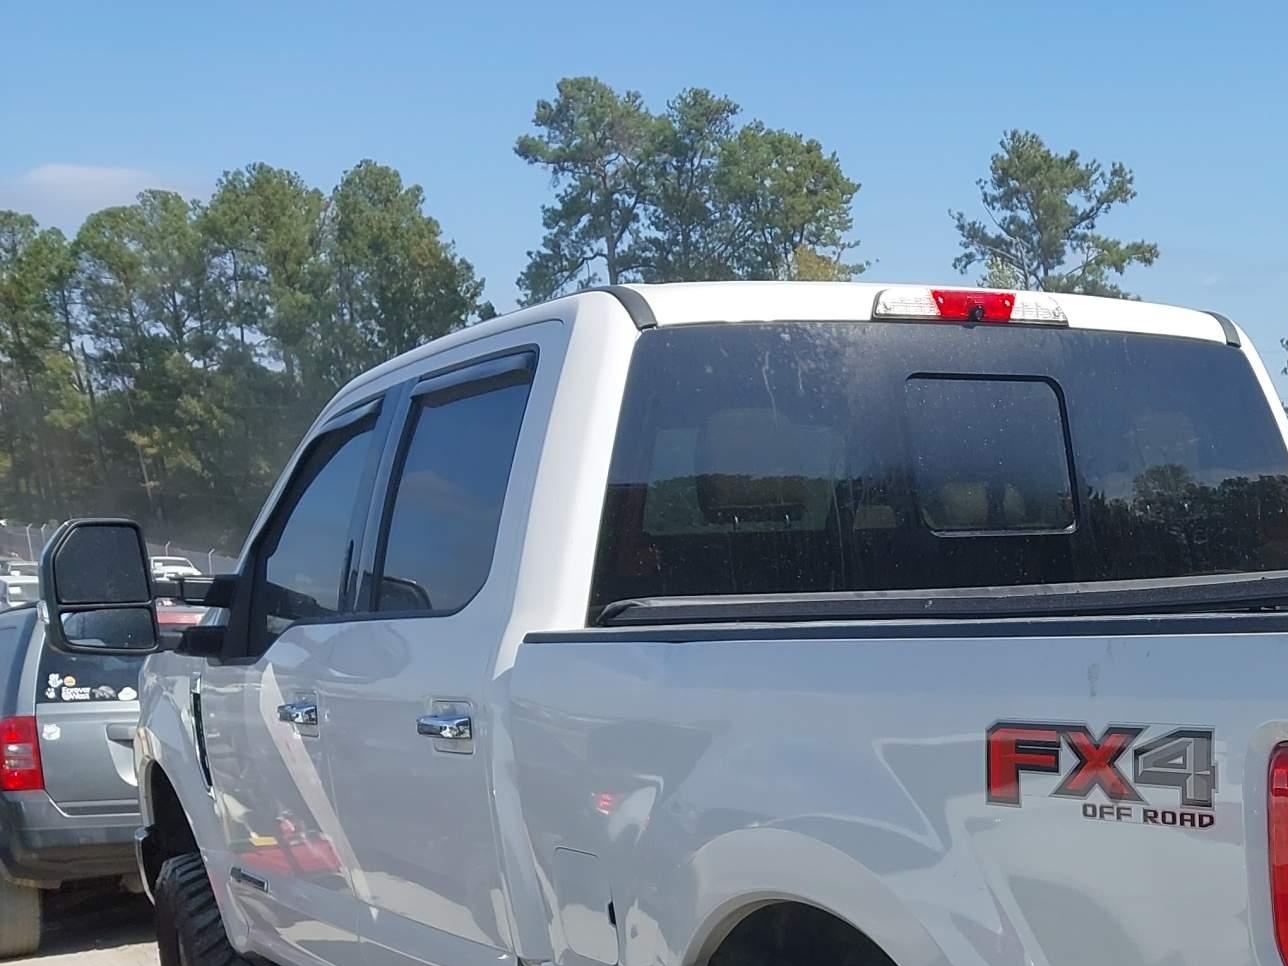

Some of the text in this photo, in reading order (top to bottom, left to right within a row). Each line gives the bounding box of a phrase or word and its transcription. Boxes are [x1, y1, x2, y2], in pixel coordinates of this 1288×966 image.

[985, 719, 1218, 808] FX4
[1082, 803, 1214, 828] OFF ROAD
